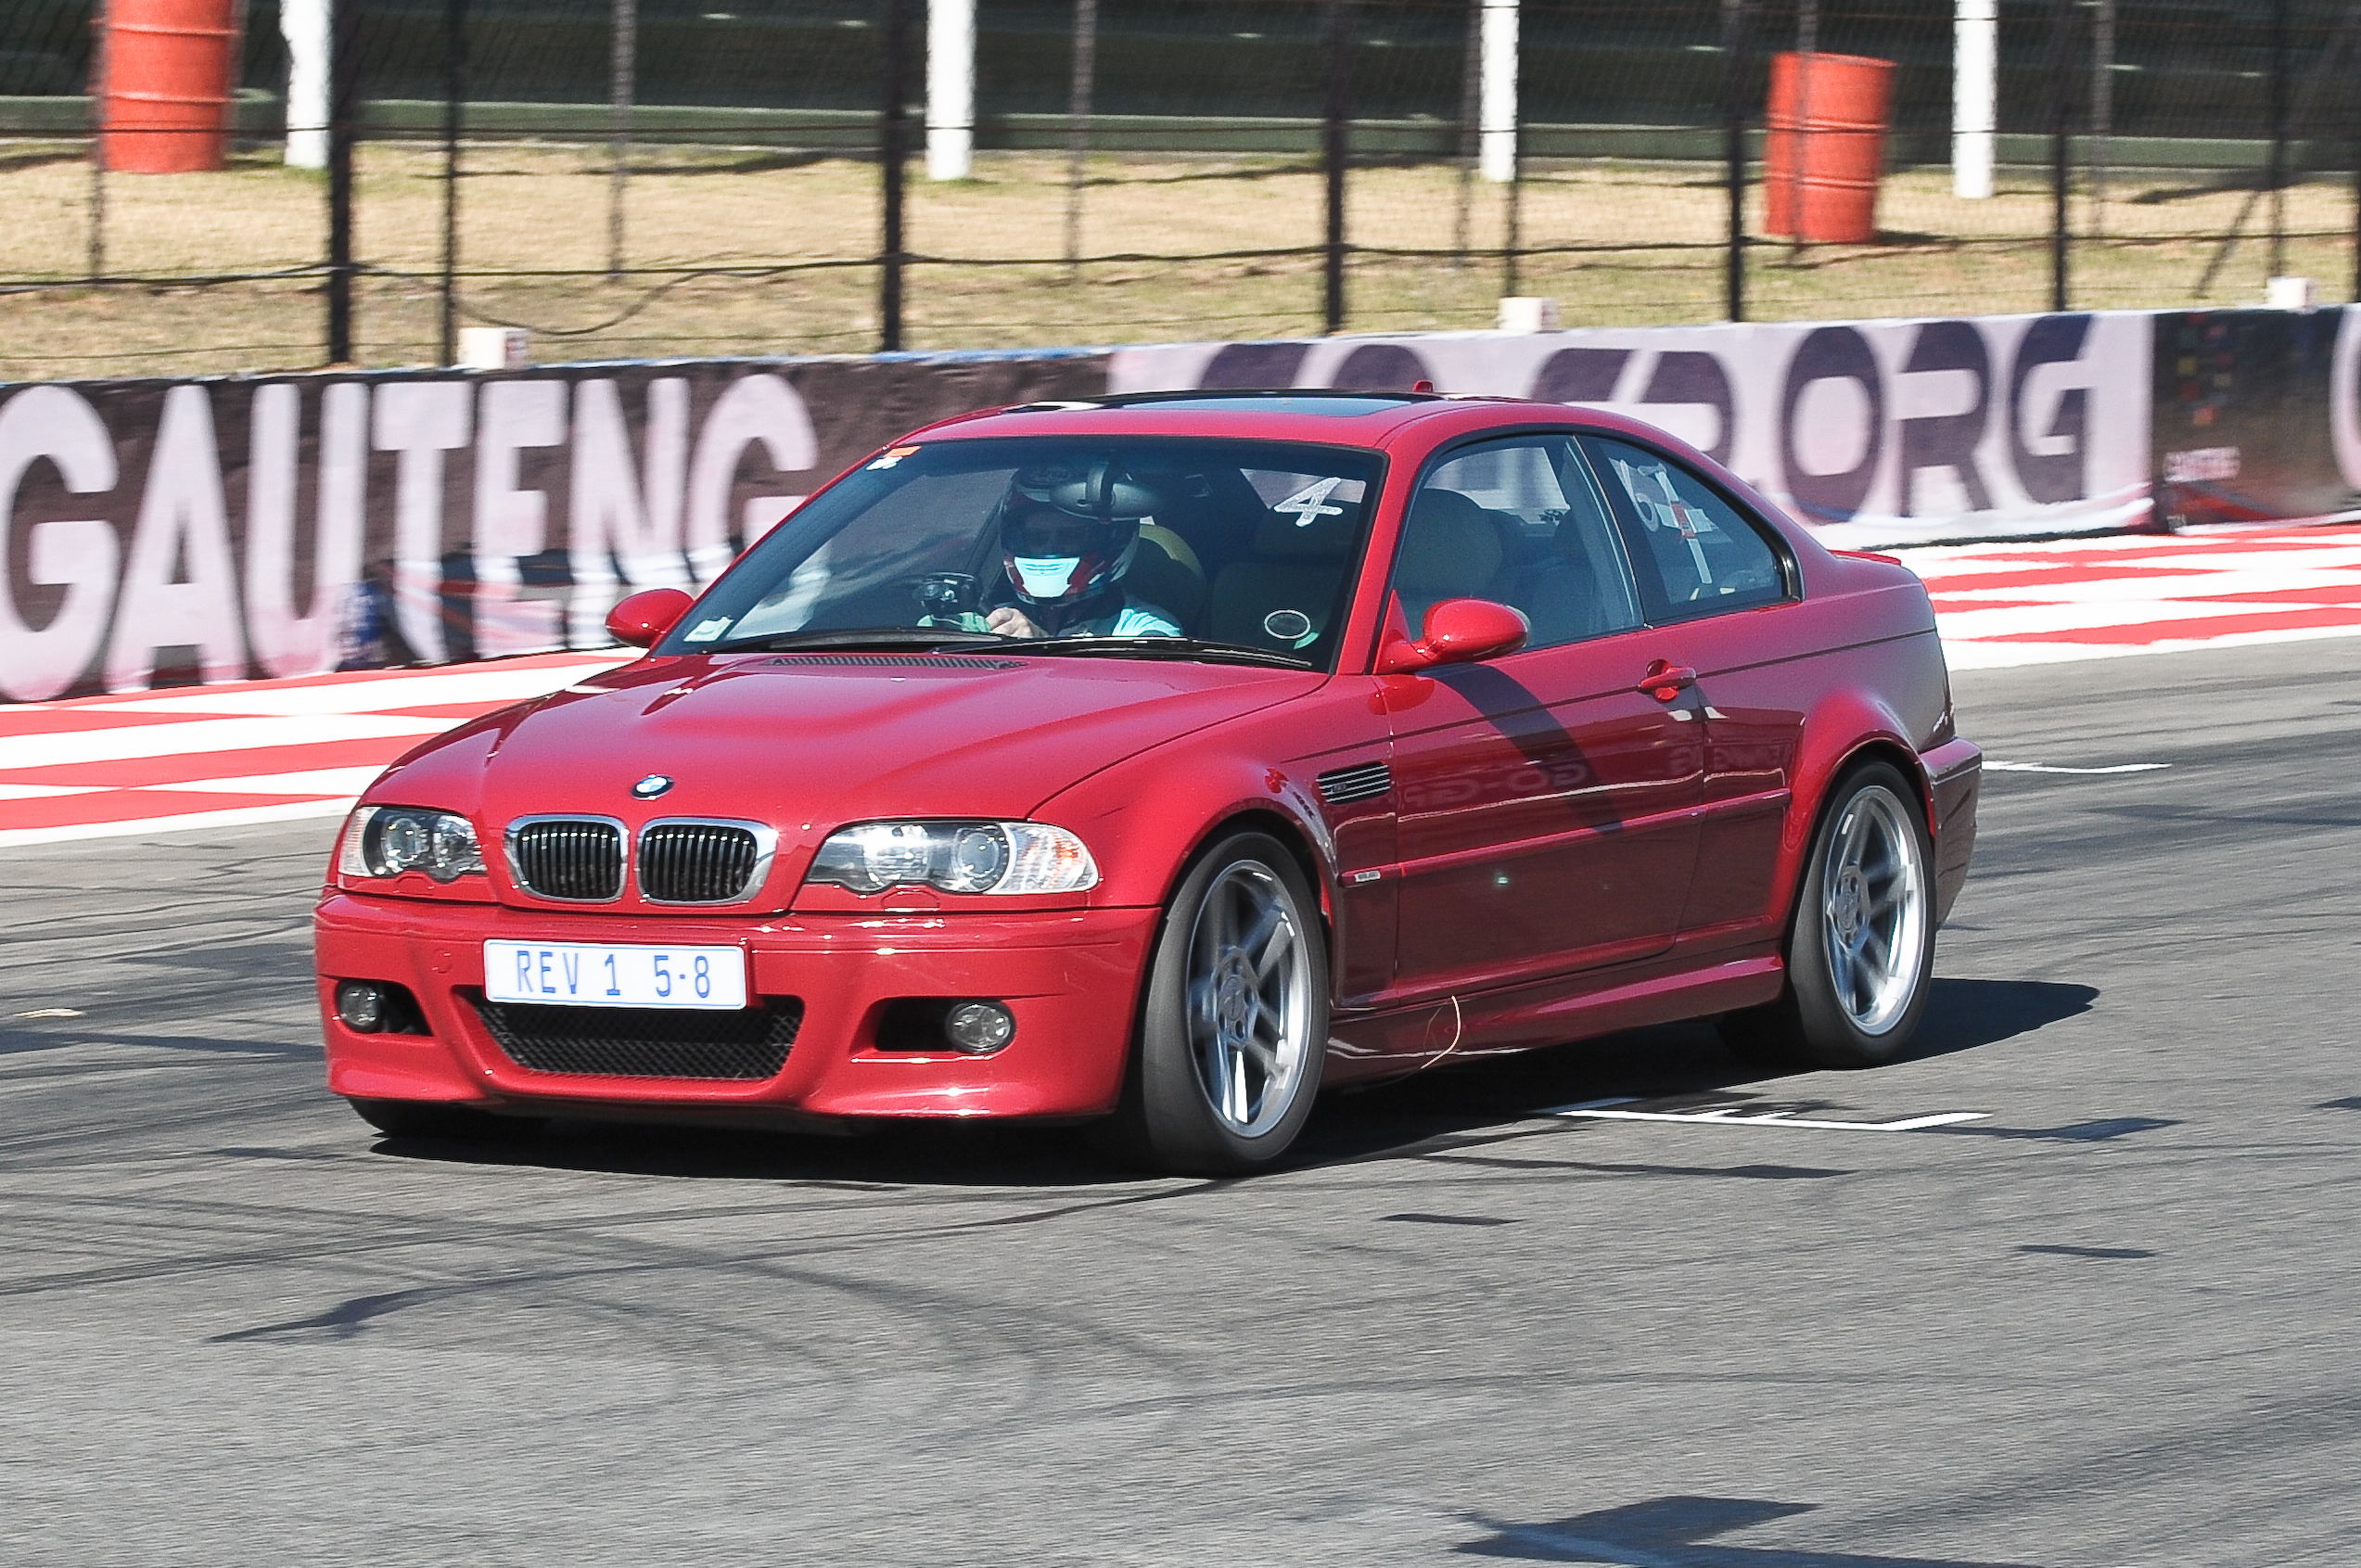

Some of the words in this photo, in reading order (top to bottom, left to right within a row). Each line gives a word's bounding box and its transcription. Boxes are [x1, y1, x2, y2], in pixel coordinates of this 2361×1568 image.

[1273, 477, 1344, 528] 4
[0, 373, 819, 702] GAUTENG
[516, 950, 580, 995] REV
[604, 953, 621, 996] 1
